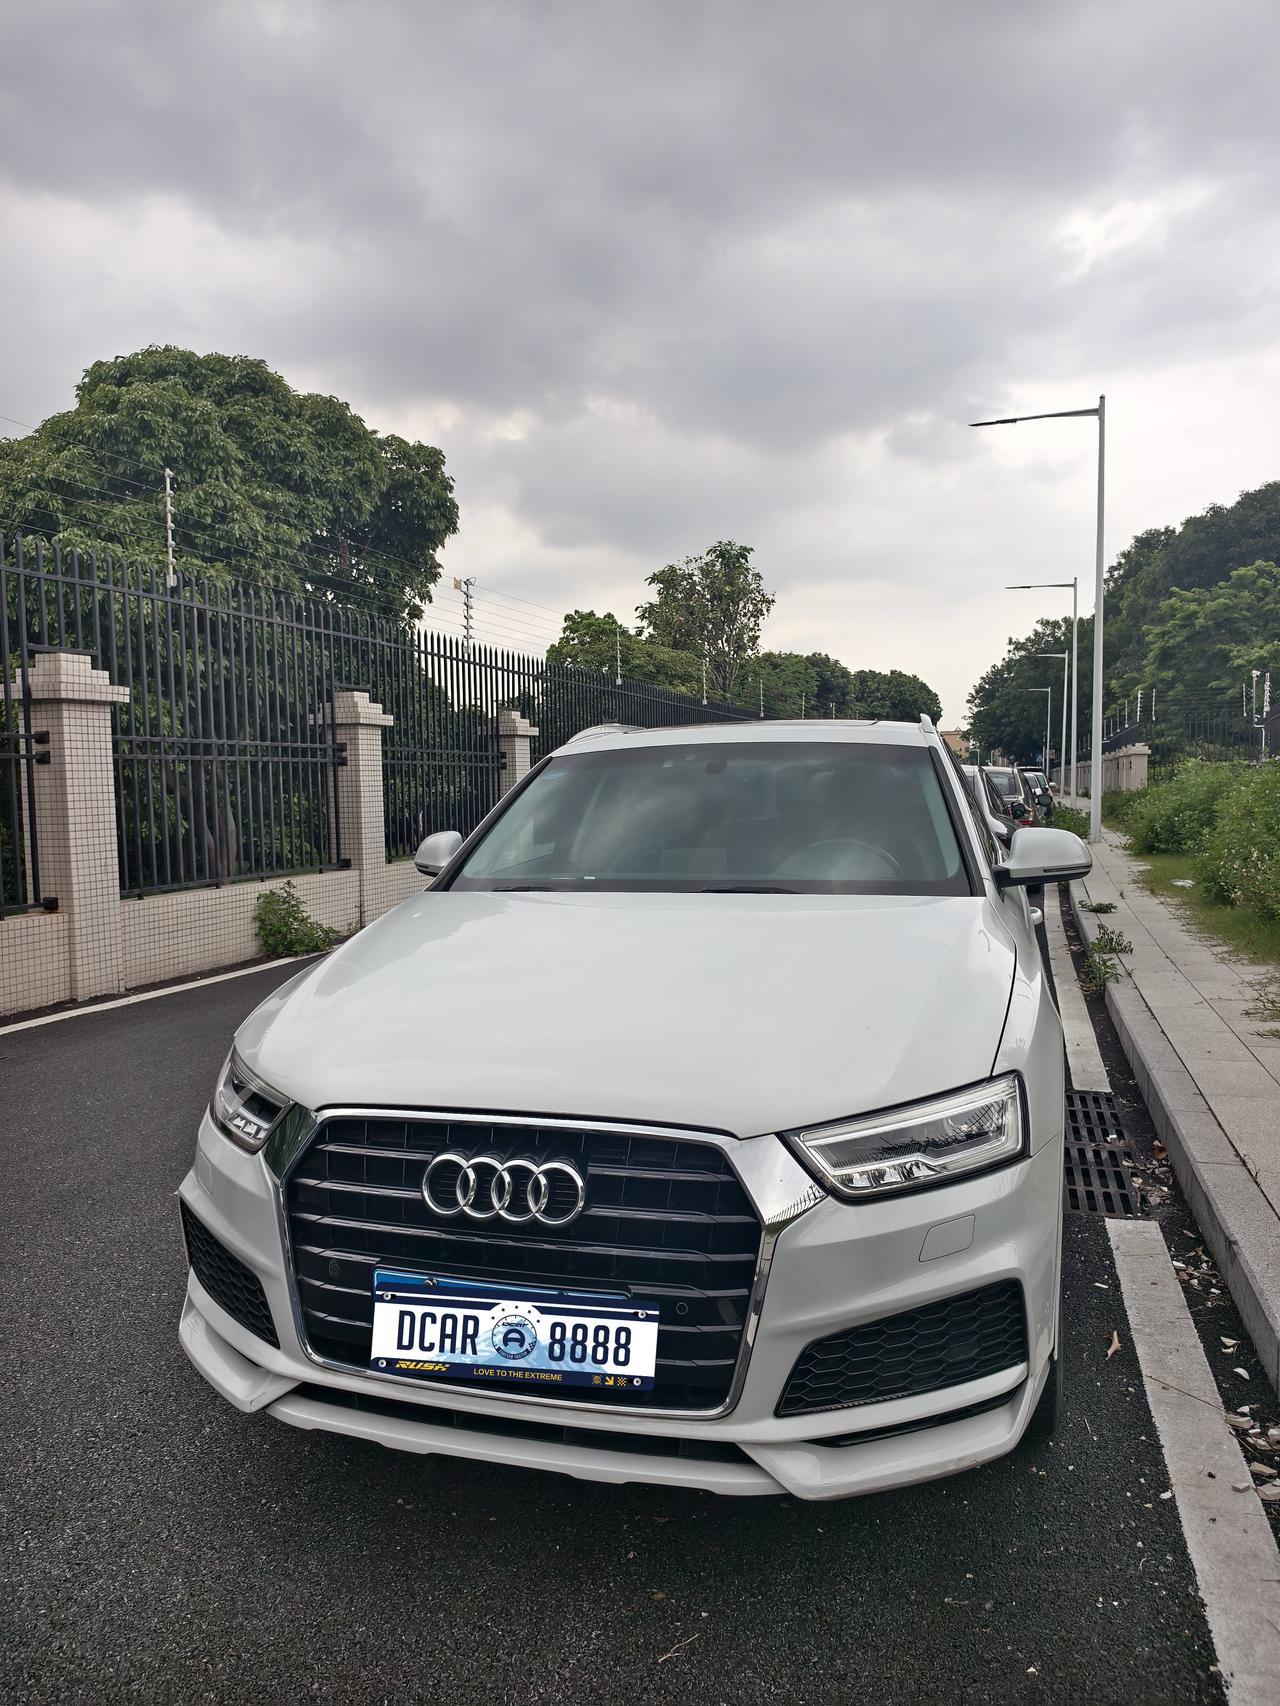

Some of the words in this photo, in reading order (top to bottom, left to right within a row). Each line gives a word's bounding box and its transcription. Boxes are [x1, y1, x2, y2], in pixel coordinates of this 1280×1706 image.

[396, 1309, 481, 1356] DCAR
[547, 1321, 632, 1367] 8888
[473, 1368, 495, 1377] LOVE
[496, 1369, 507, 1378] TO
[508, 1370, 524, 1379] THE
[525, 1371, 562, 1381] EXTREME
